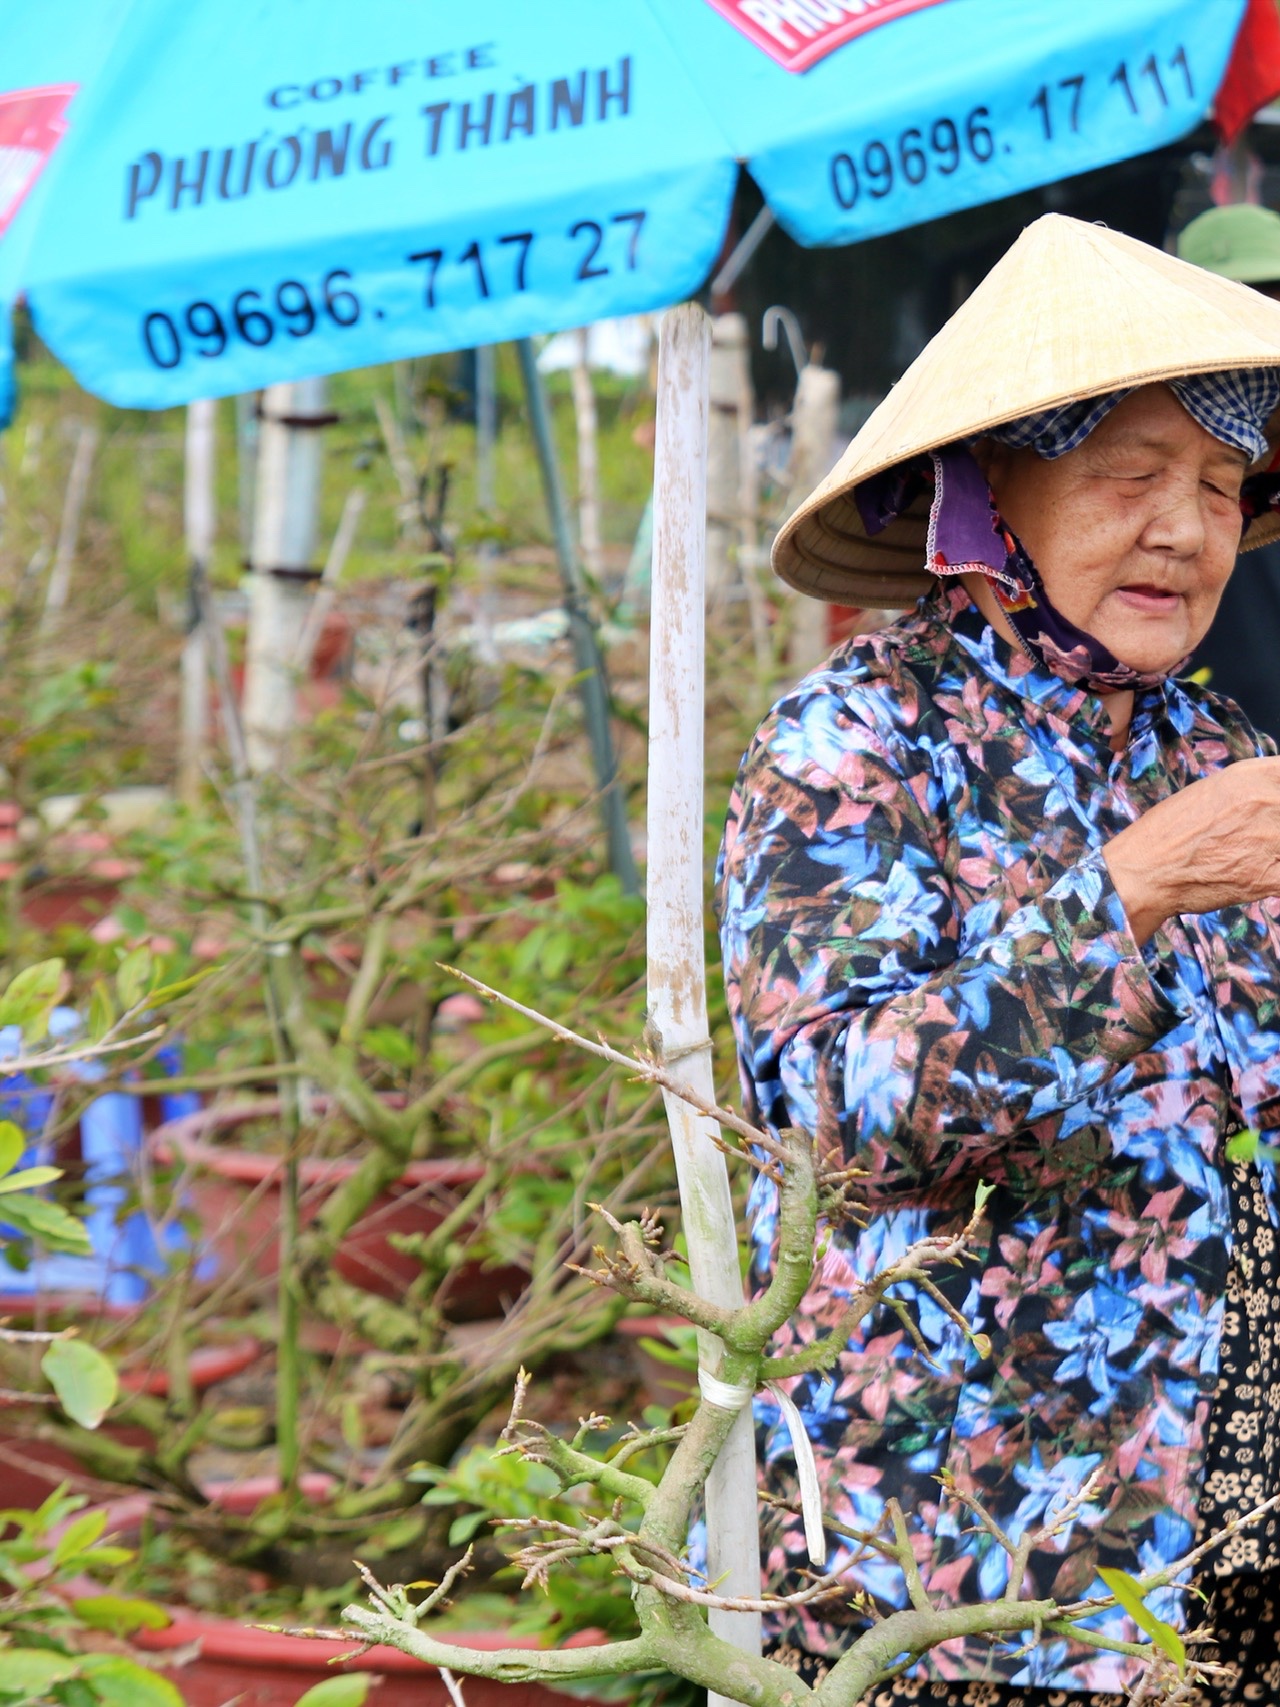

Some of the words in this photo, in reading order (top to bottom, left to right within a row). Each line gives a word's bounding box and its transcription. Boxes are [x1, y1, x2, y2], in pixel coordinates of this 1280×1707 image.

[123, 115, 393, 221] PHƯƠNG
[420, 54, 634, 159] THÀNH
[266, 41, 497, 110] COFFEE
[833, 104, 1013, 211] 09696.
[1029, 73, 1085, 141] 17
[1108, 43, 1195, 117] 111
[143, 268, 385, 370] 09696.
[406, 231, 534, 308] 717
[567, 209, 647, 282] 27
